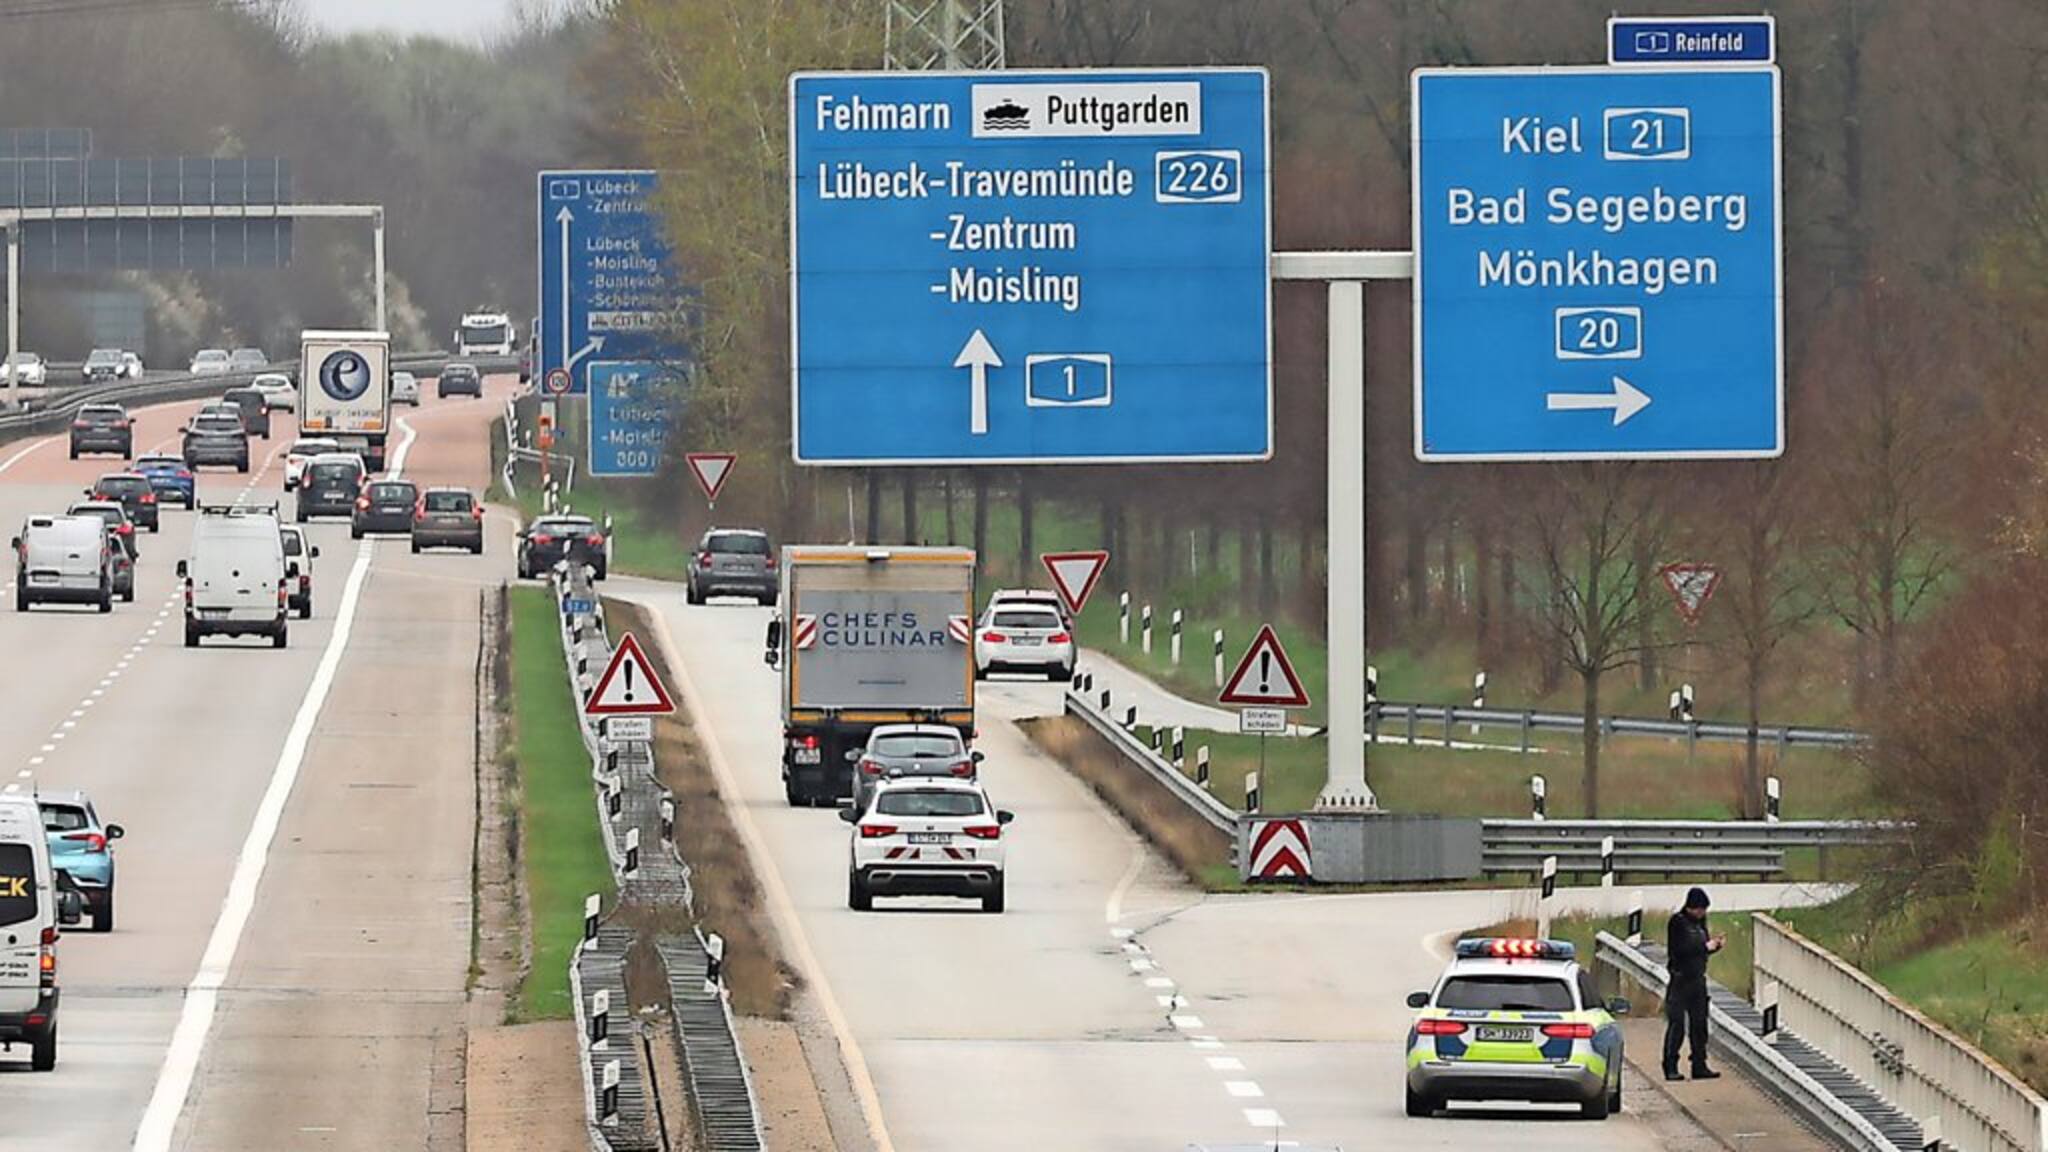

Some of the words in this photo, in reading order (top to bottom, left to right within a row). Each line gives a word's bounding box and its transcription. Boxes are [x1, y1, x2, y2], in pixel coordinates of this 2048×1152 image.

[1650, 34, 1657, 50] 1
[1675, 33, 1743, 52] Reinfeld
[816, 95, 950, 131] Fehmarn
[1047, 94, 1189, 132] Puttgarden
[1502, 117, 1583, 153] Kiel
[1631, 119, 1665, 150] 21
[586, 180, 639, 195] Lübeck
[818, 160, 1134, 199] Lübeck-Travemünde
[1167, 161, 1229, 193] 226
[1447, 187, 1525, 225] Bad
[1546, 186, 1748, 233] Segeberg
[586, 237, 640, 252] Lübeck
[929, 213, 1077, 251] -Zentrum
[930, 266, 1079, 312] -Moisling
[1478, 249, 1718, 296] Mönkhagen
[1578, 317, 1620, 349] 20
[1062, 364, 1077, 397] 1
[823, 612, 918, 628] CHEFS
[823, 631, 945, 646] CULINAR
